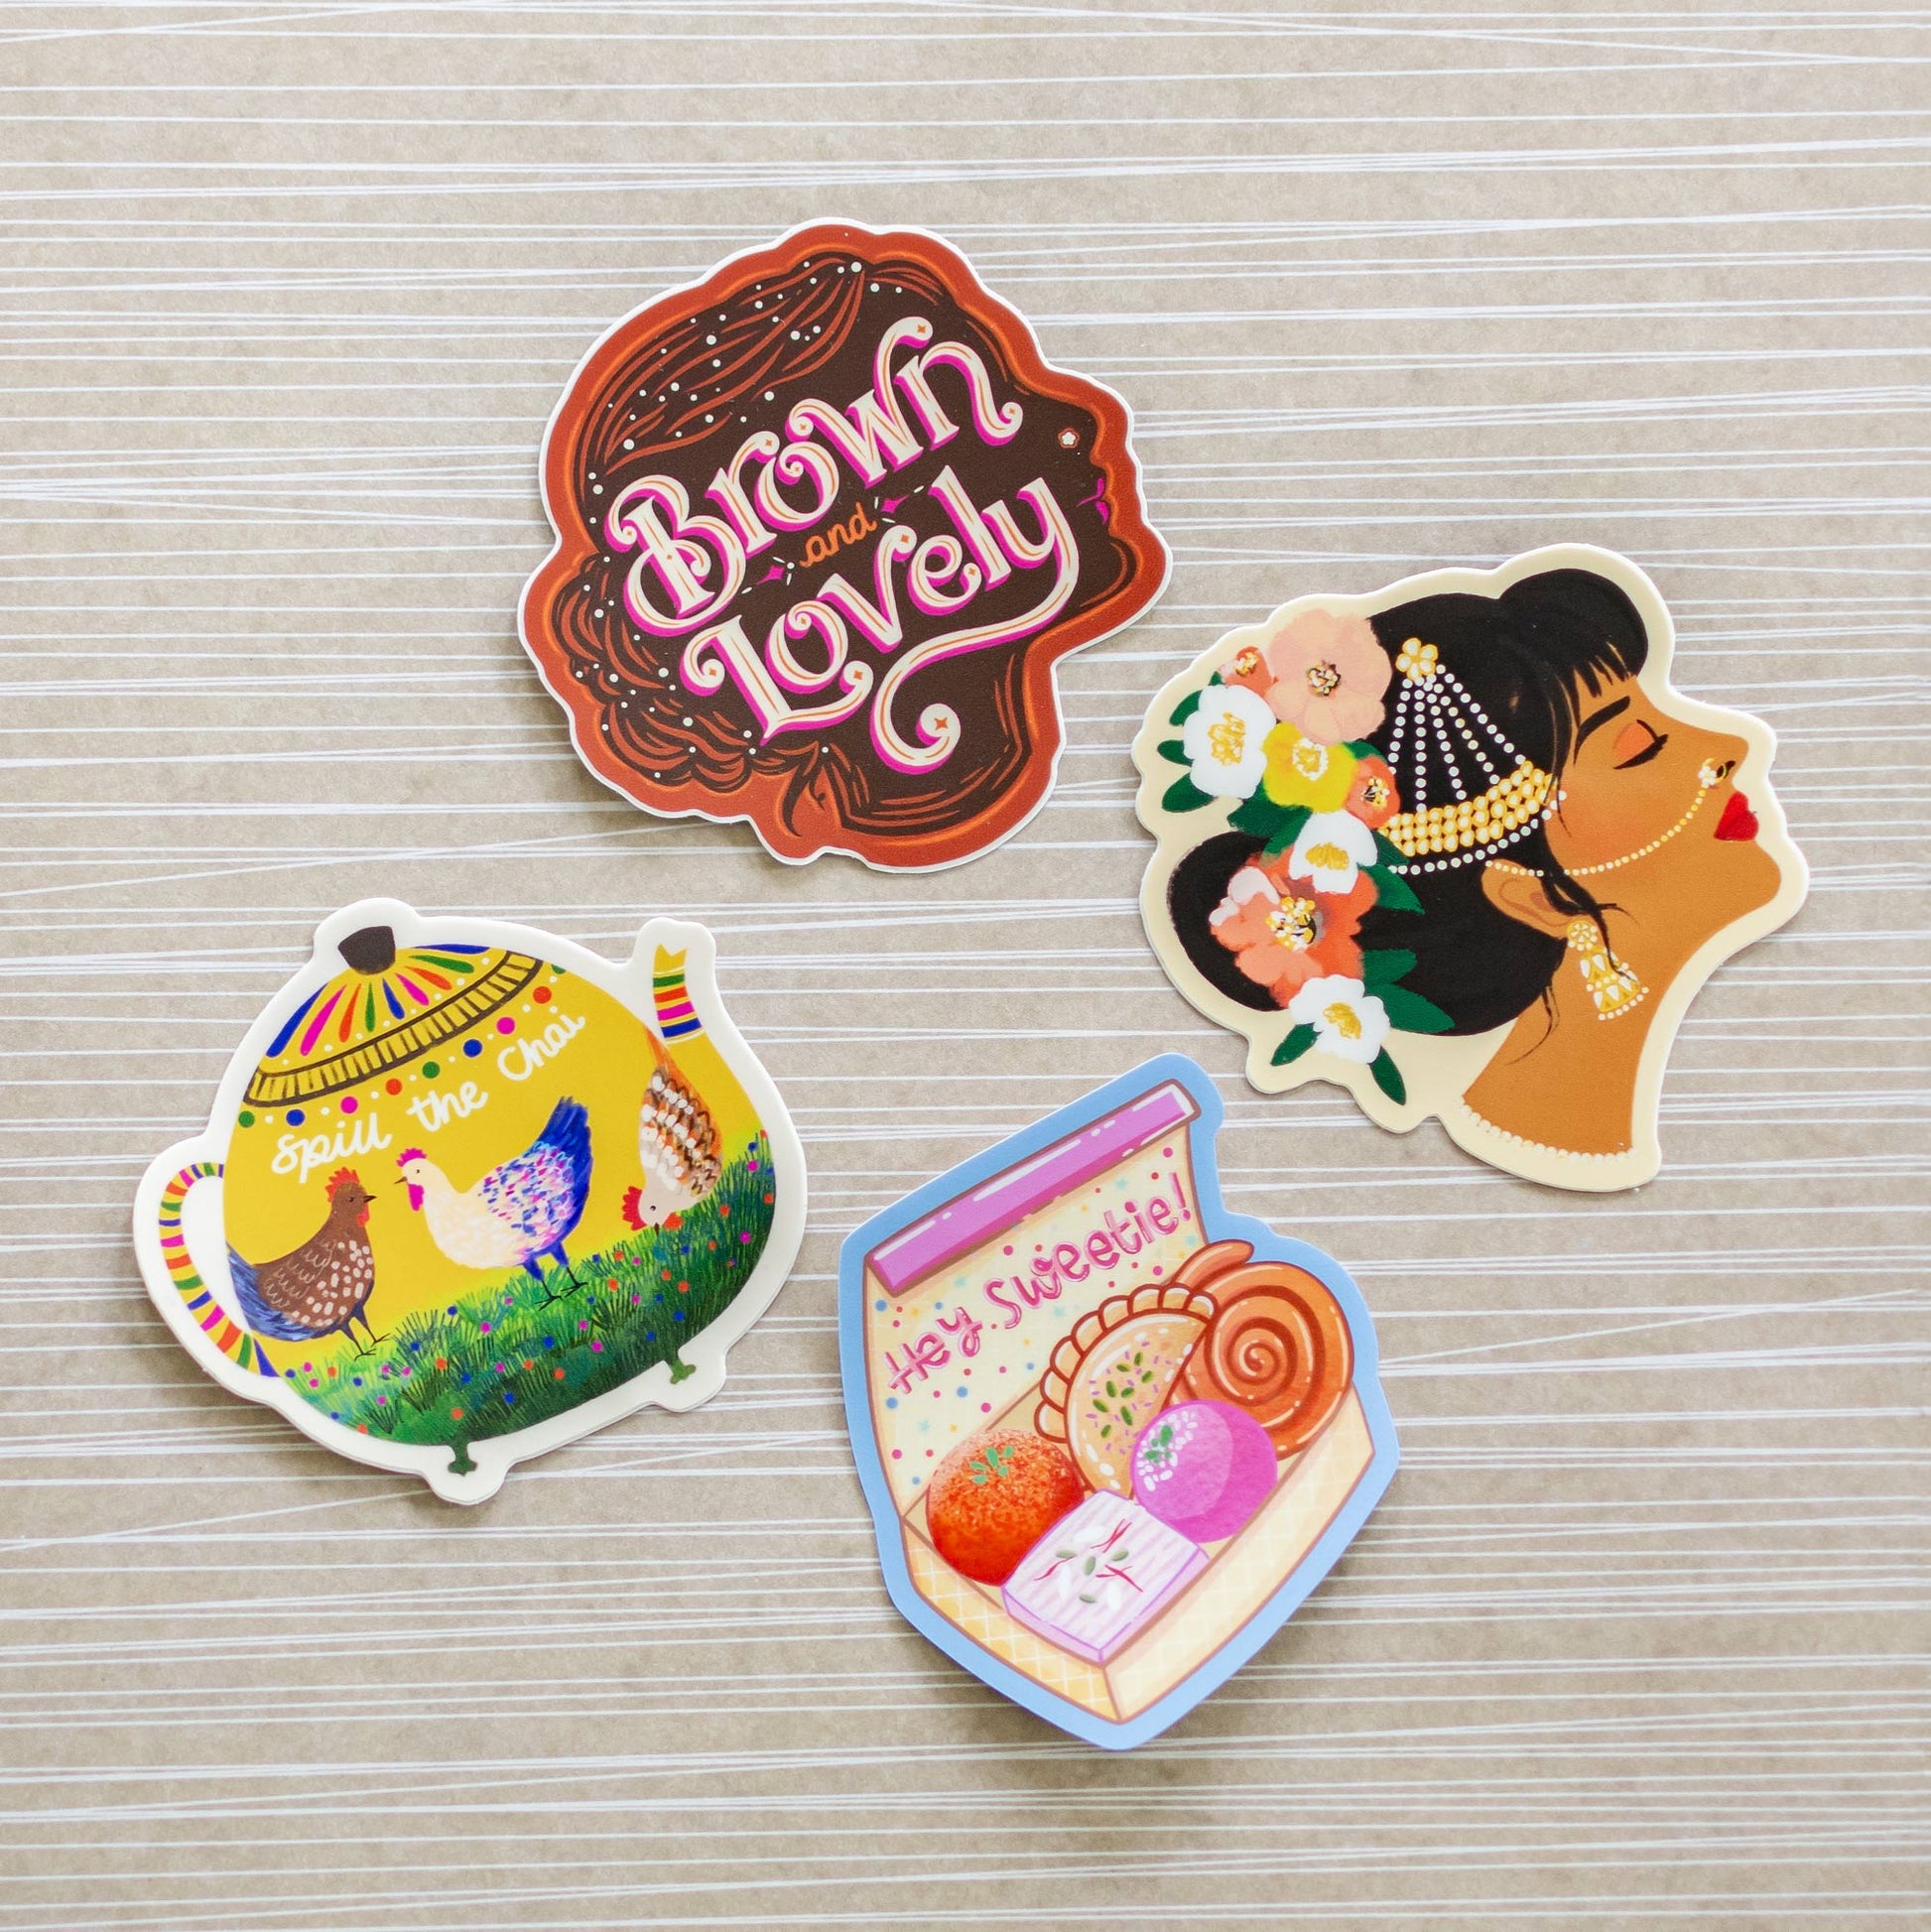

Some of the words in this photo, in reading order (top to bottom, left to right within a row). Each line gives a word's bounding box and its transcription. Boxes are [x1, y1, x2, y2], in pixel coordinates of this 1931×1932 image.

[604, 317, 1023, 637] Brown
[800, 502, 877, 567] and
[680, 464, 1080, 775] Lovely
[406, 1081, 488, 1132] the
[496, 1008, 586, 1082] Chai
[883, 1306, 983, 1395] Hey
[982, 1171, 1192, 1331] Sweetie!
